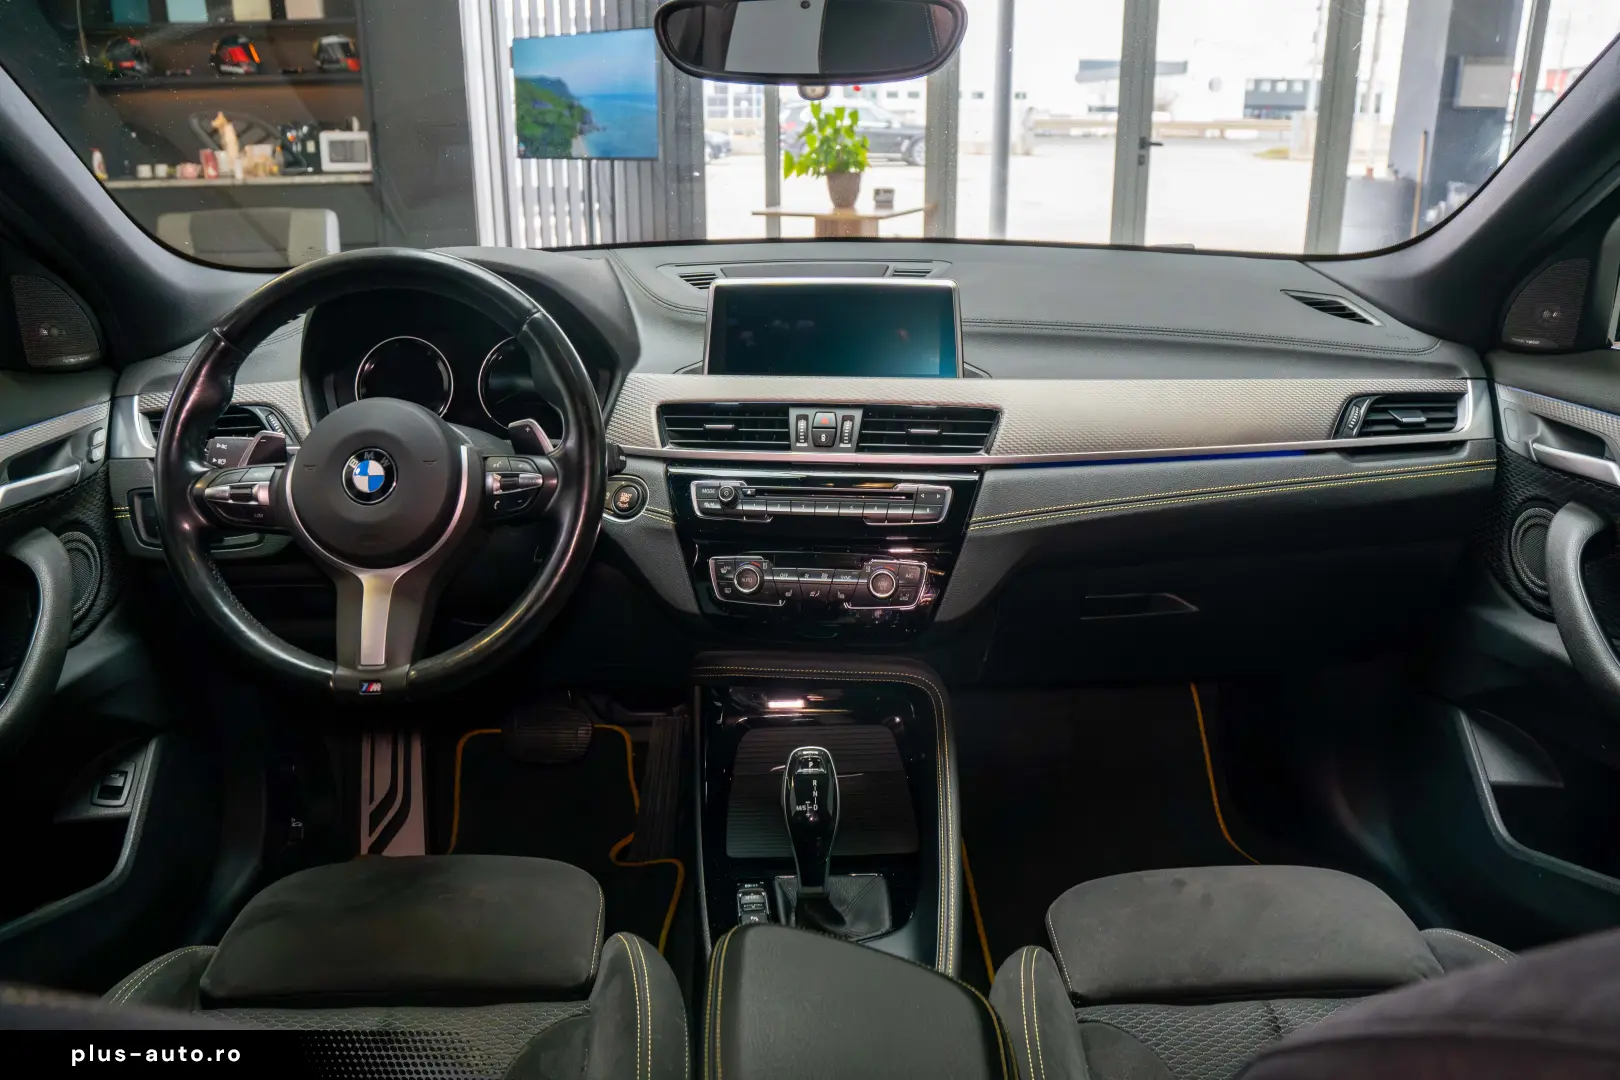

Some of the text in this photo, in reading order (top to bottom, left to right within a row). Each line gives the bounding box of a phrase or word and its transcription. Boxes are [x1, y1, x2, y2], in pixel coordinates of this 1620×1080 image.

[349, 451, 391, 468] BMW
[812, 779, 818, 787] R
[812, 790, 818, 798] N
